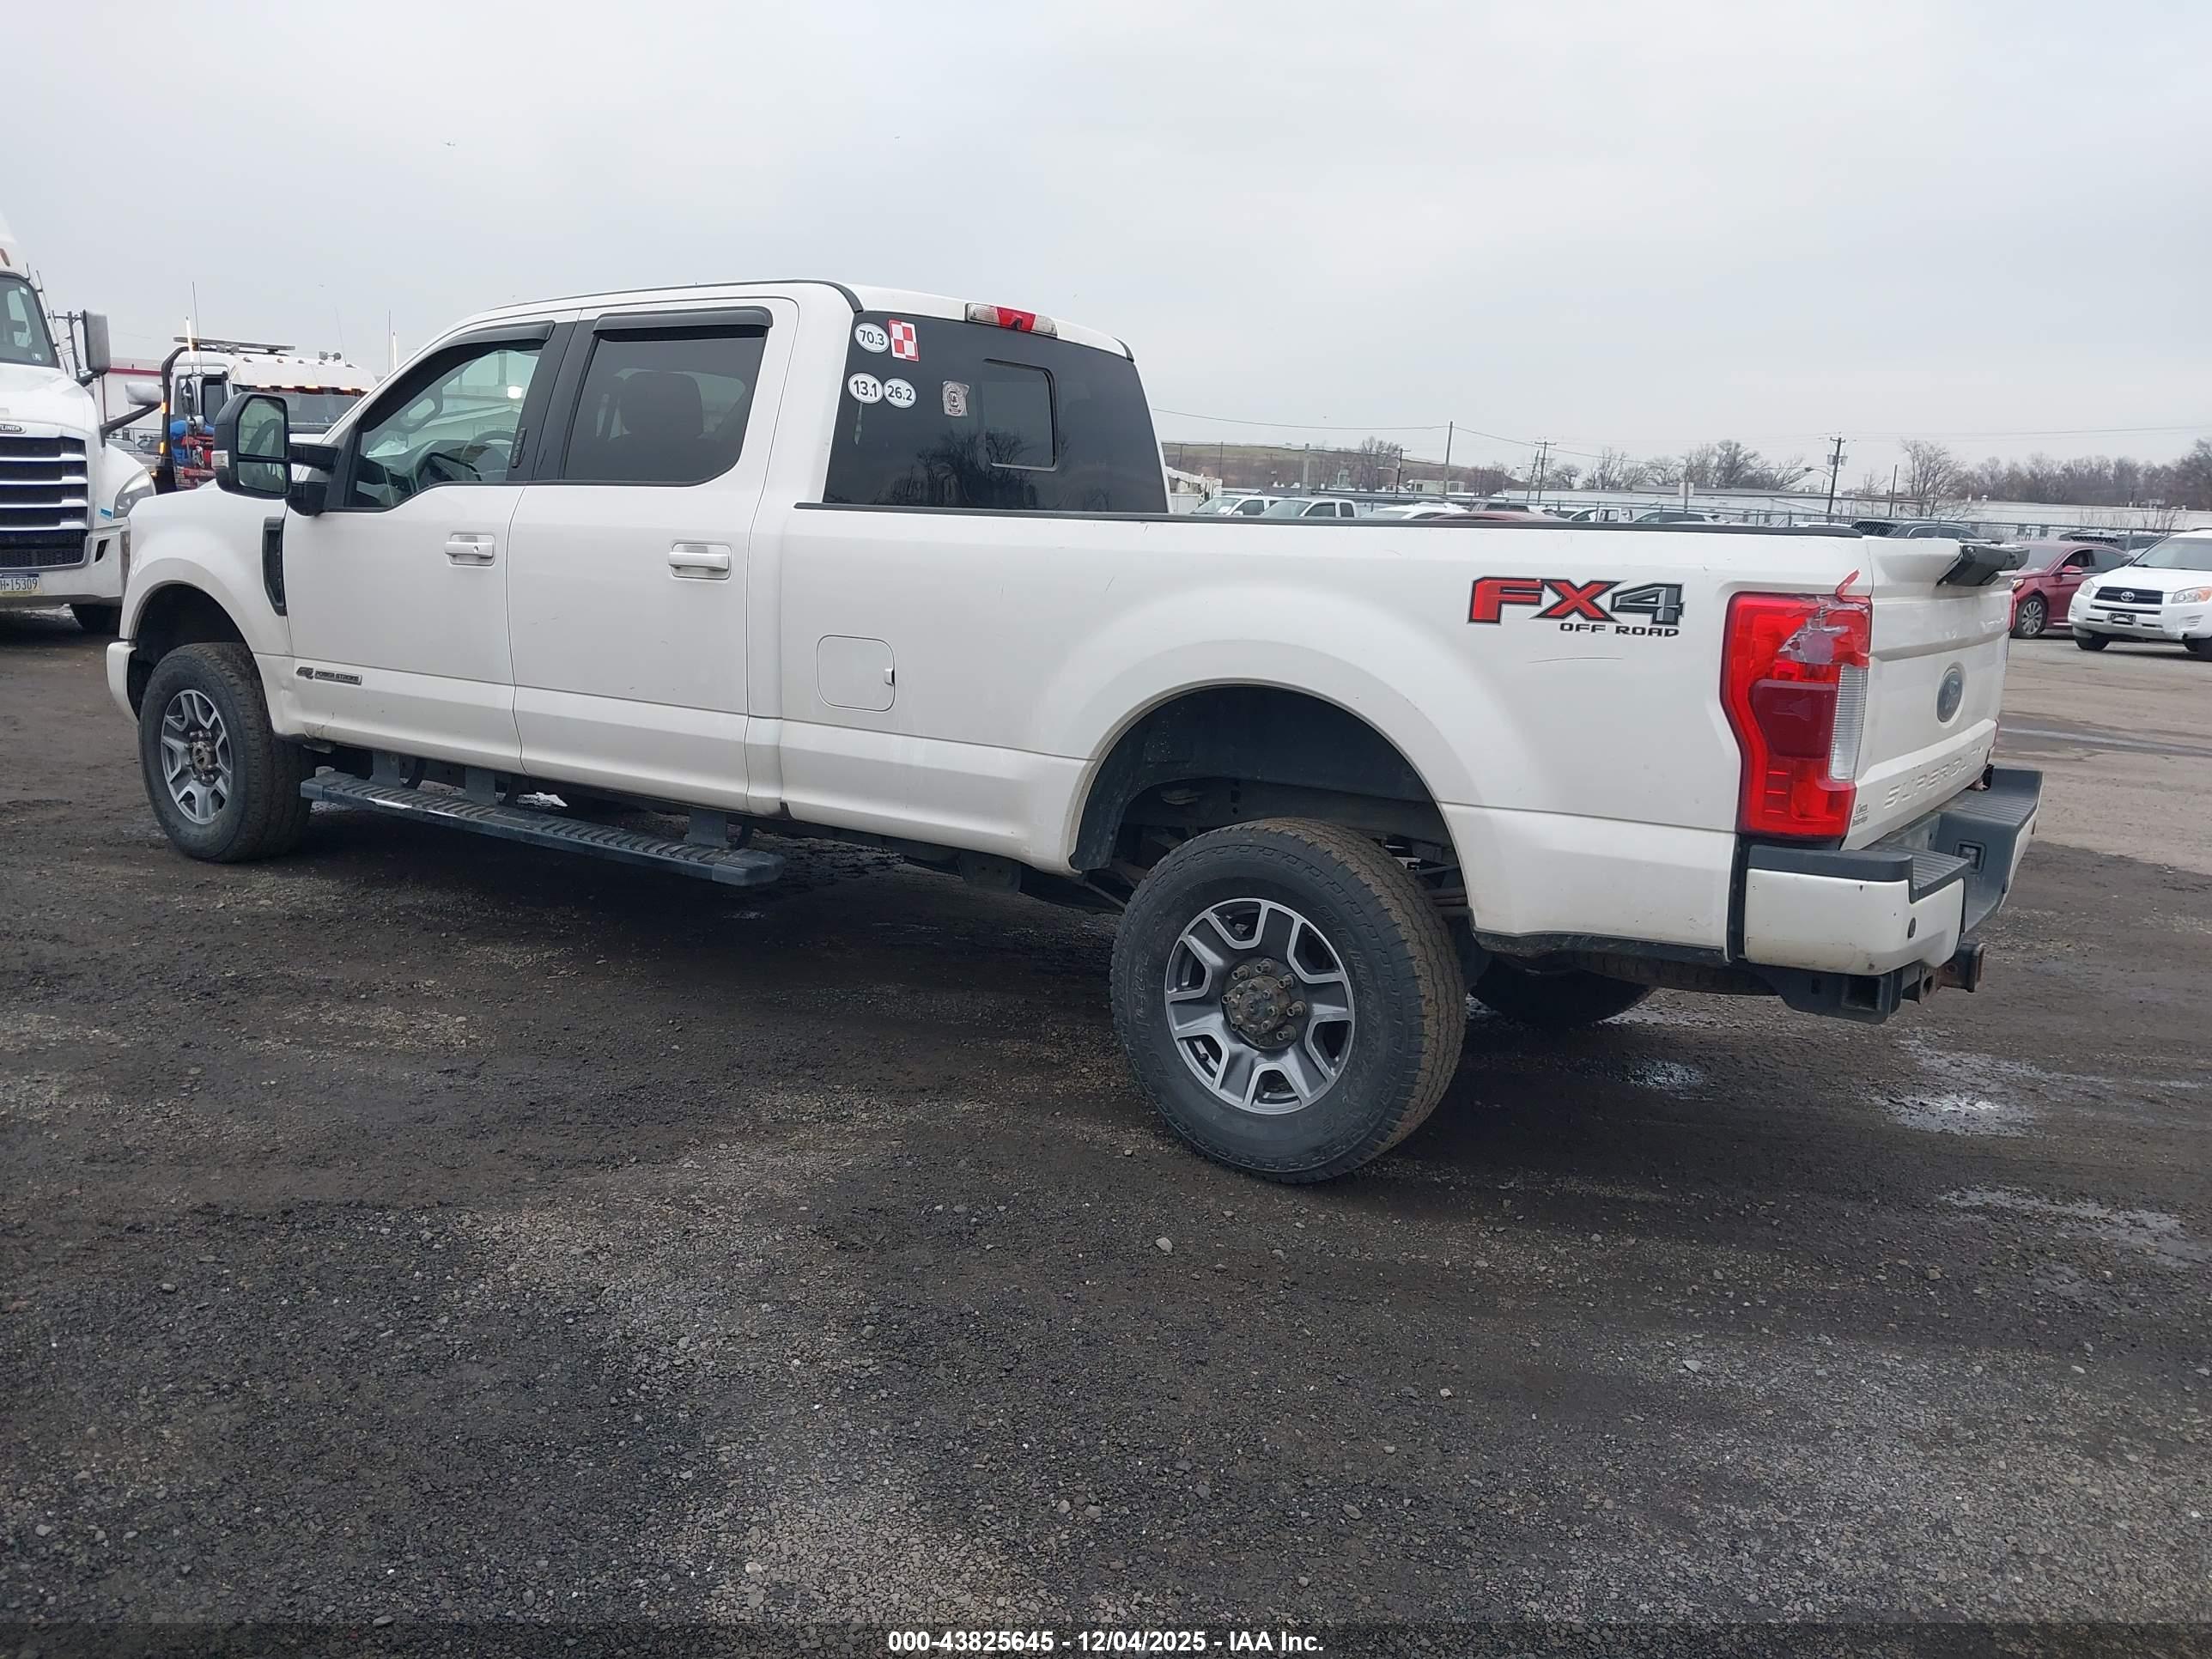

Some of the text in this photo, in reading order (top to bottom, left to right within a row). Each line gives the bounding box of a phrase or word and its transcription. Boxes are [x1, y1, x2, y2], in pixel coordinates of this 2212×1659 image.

[860, 329, 884, 346] 70.3
[854, 380, 878, 398] 13.1
[887, 385, 913, 402] 26.2
[1467, 576, 1685, 626] FX4
[1559, 623, 1679, 637] OFF ROAD
